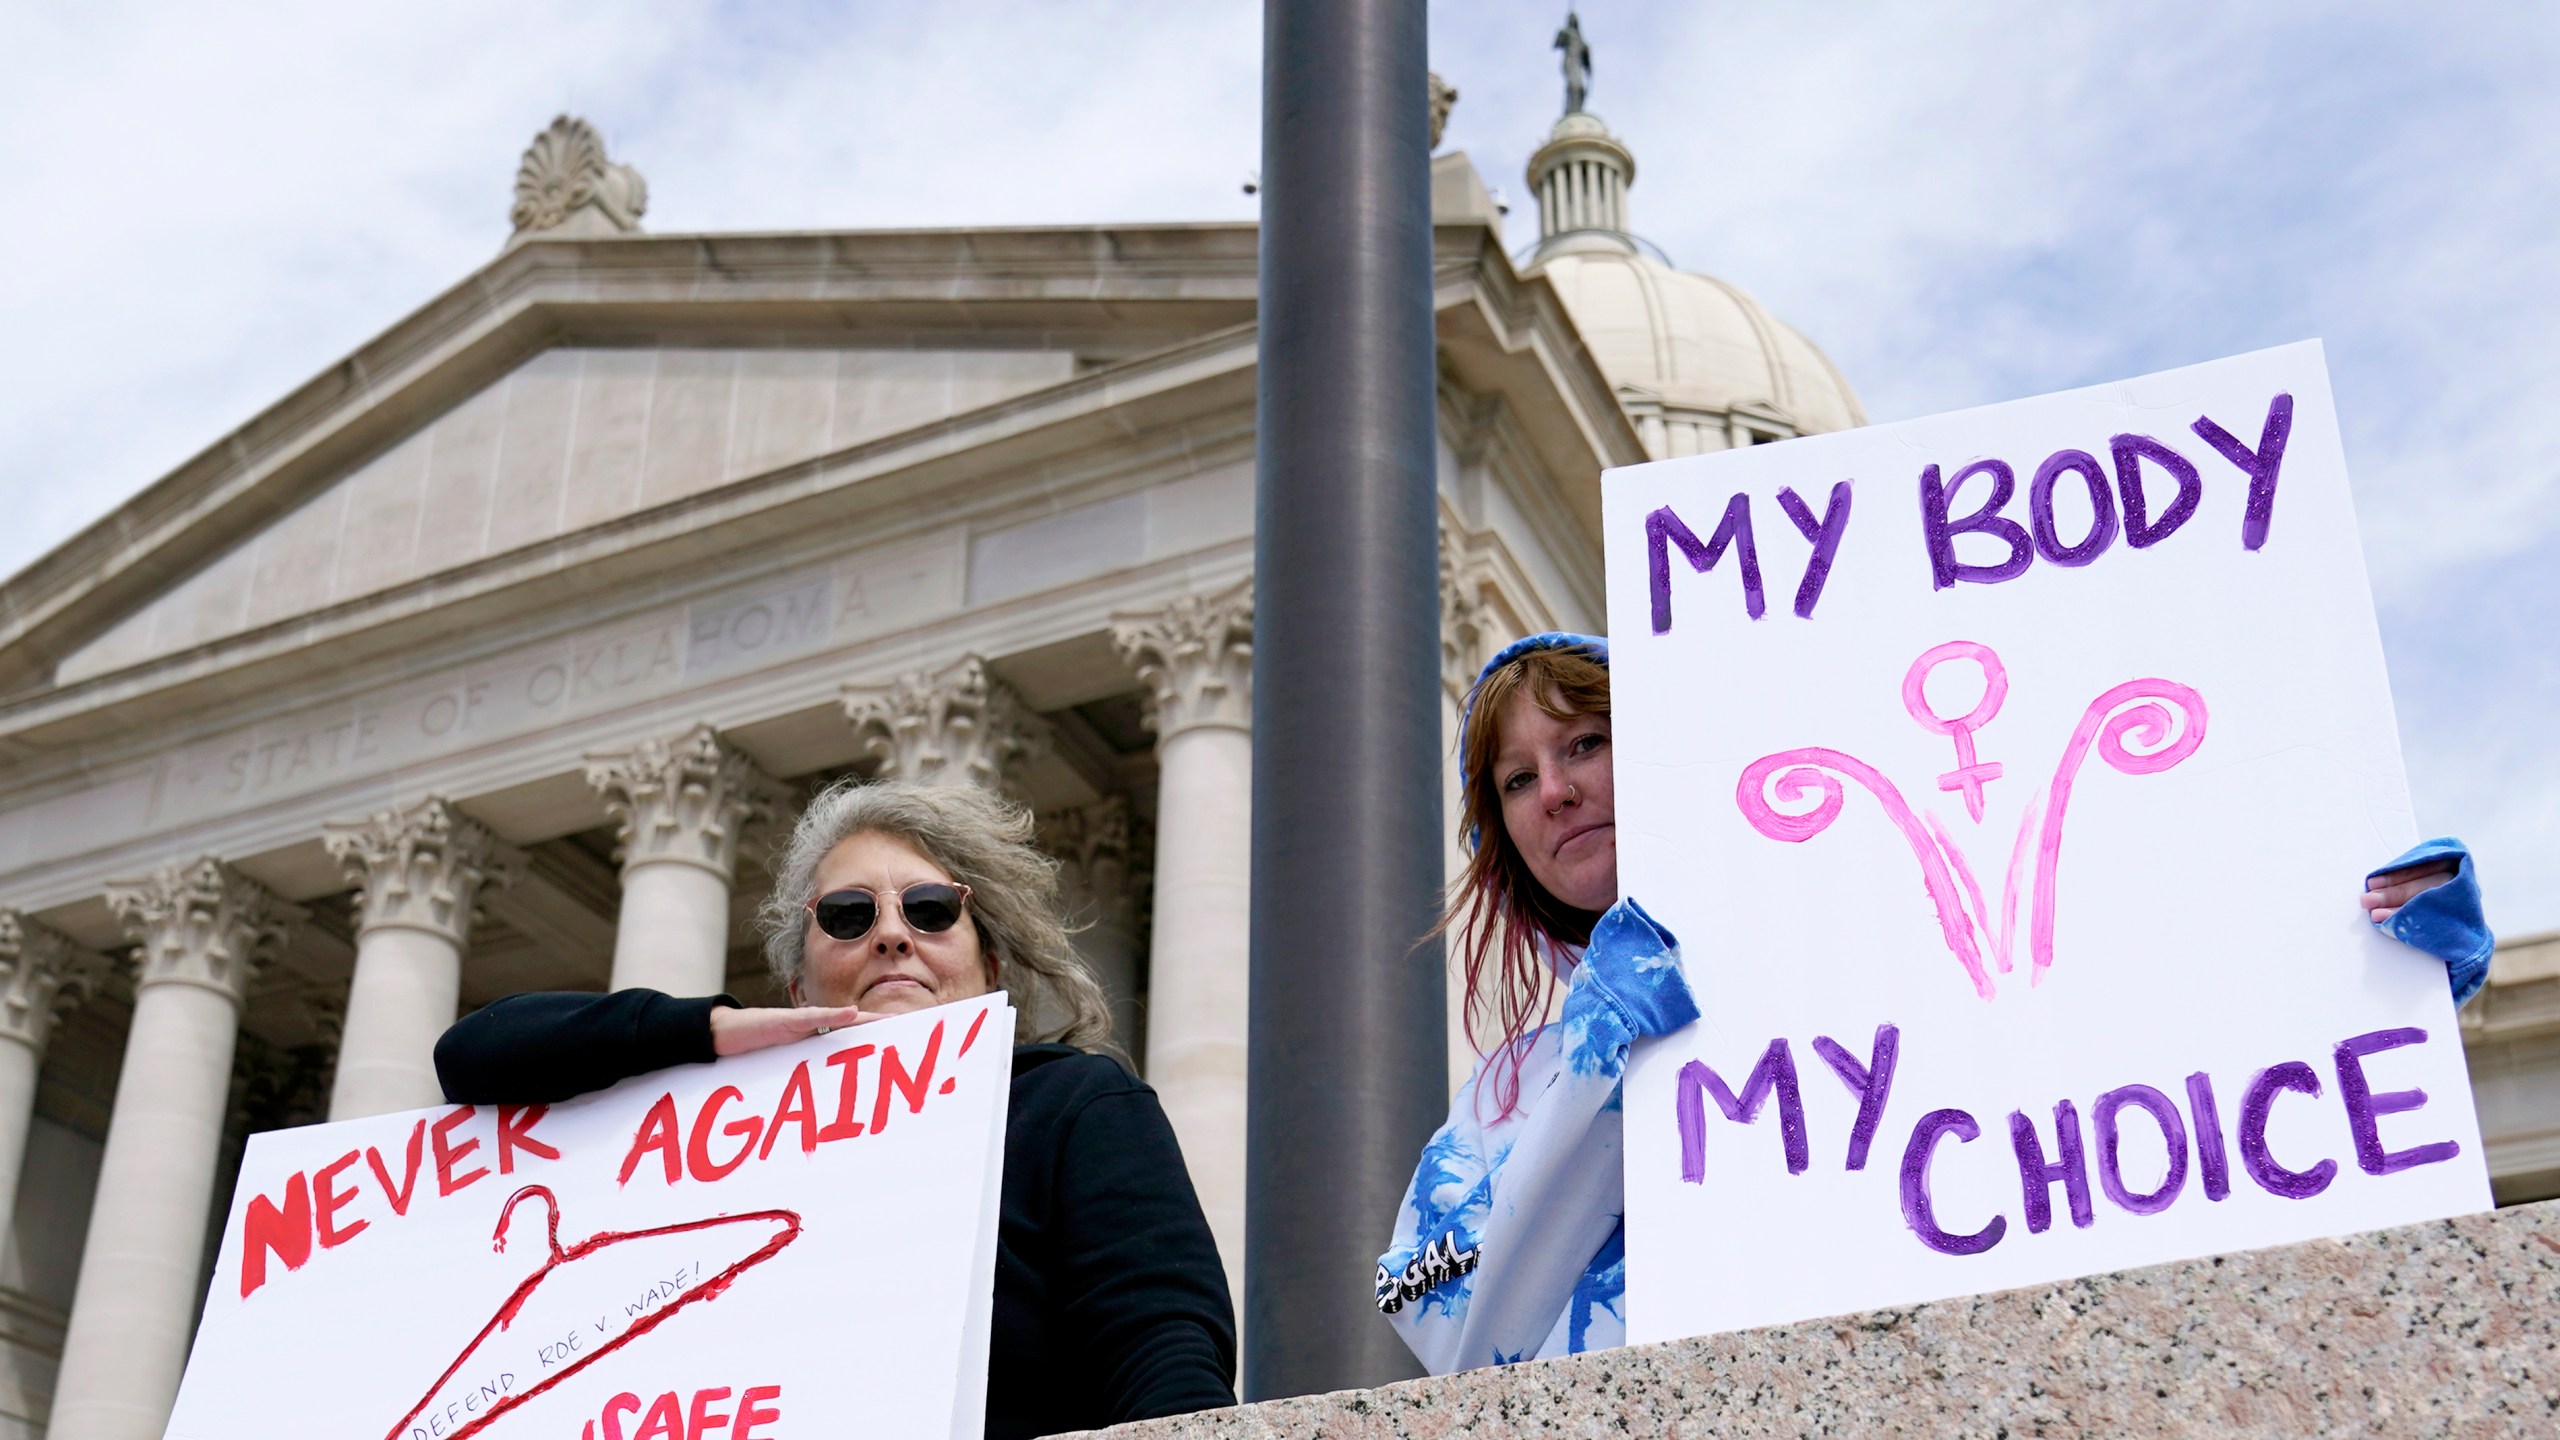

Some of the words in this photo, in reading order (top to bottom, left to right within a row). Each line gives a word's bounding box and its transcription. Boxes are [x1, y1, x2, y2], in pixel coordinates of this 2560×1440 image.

[1645, 480, 1854, 637] MY
[1918, 392, 2293, 593] BODY
[223, 712, 382, 795] STATE
[420, 681, 491, 737] OF
[526, 574, 874, 706] OKLAHOMA
[240, 1104, 561, 1301] NEVER
[617, 1007, 989, 1189] AGAIN!
[1676, 1022, 1900, 1185] MY
[1899, 1027, 2461, 1257] CHOICE
[412, 1372, 516, 1440] DEFEND
[538, 1330, 583, 1368] ROE
[624, 1260, 700, 1317] WADE!
